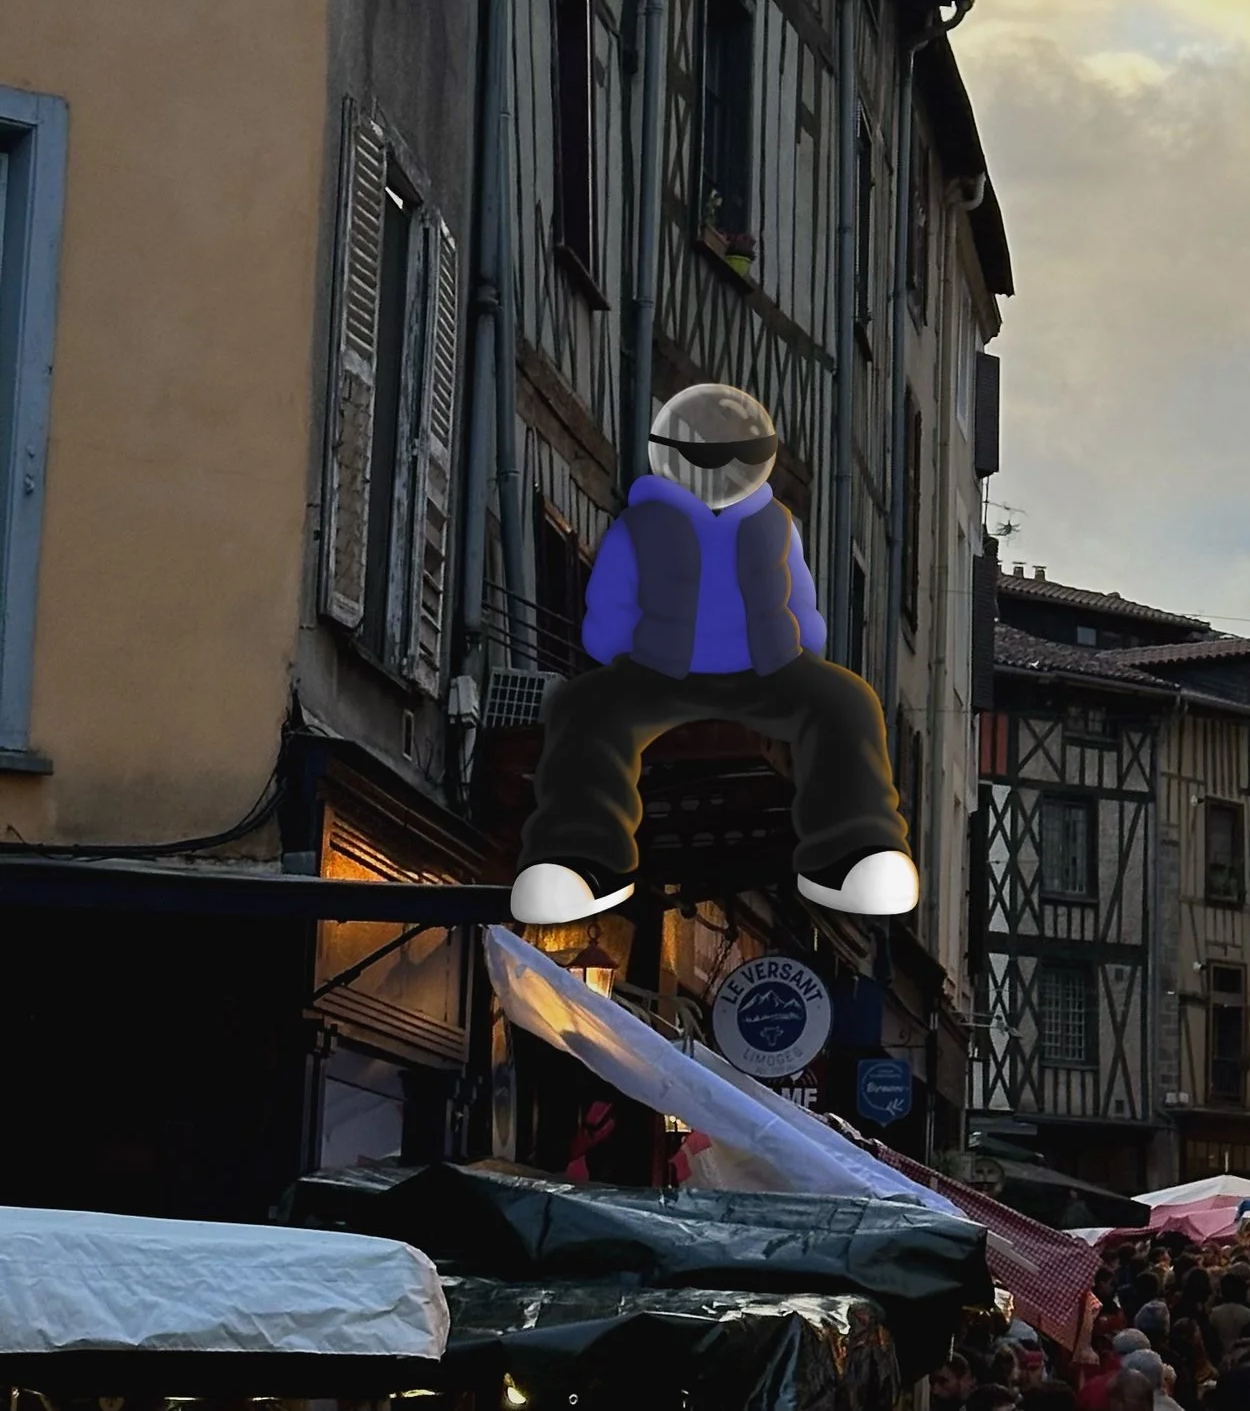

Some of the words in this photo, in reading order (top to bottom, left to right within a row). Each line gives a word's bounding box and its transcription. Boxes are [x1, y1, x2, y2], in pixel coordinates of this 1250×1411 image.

[720, 980, 745, 1005] LE
[741, 961, 823, 1002] VERSANT
[742, 1048, 803, 1066] LIMOGES
